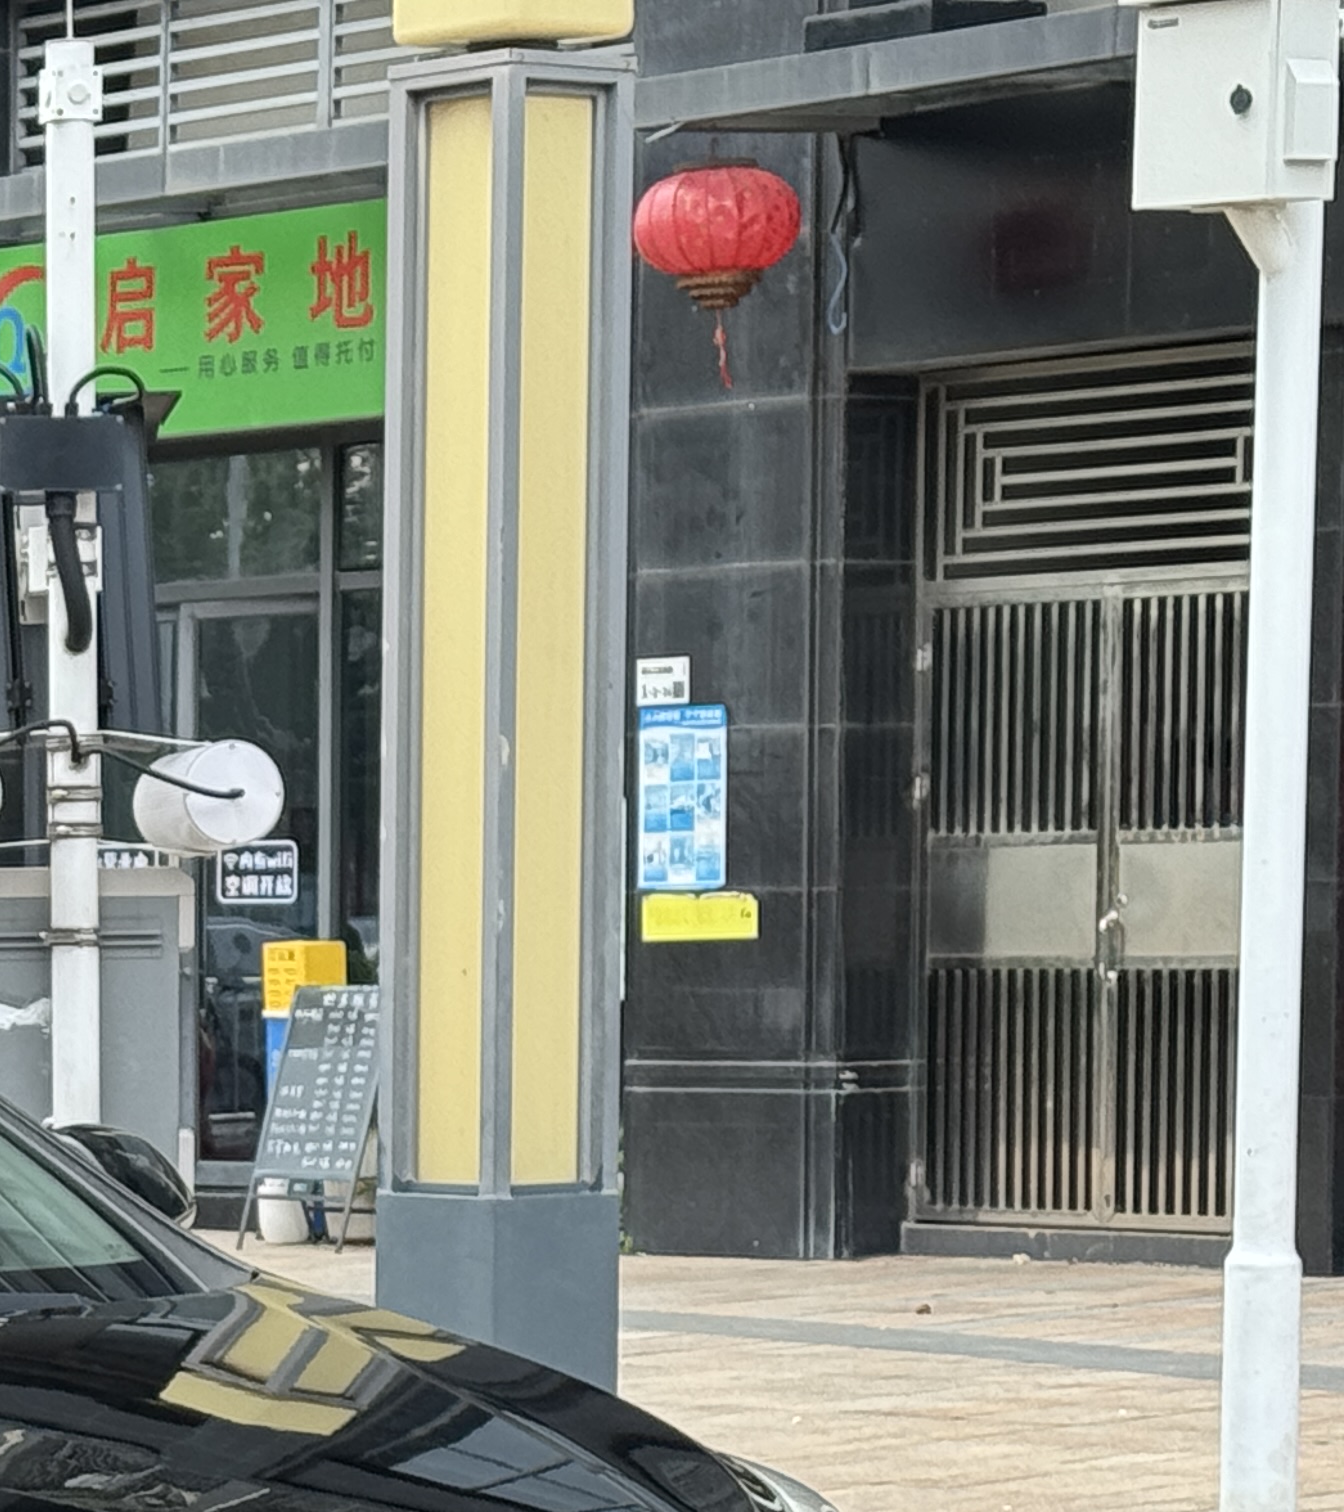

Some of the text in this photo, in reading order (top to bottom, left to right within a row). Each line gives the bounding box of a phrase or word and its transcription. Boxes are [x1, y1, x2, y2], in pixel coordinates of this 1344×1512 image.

[99, 230, 375, 355] 启家地
[198, 338, 376, 379] 用心服务 值得托付
[224, 873, 293, 897] 空调开放
